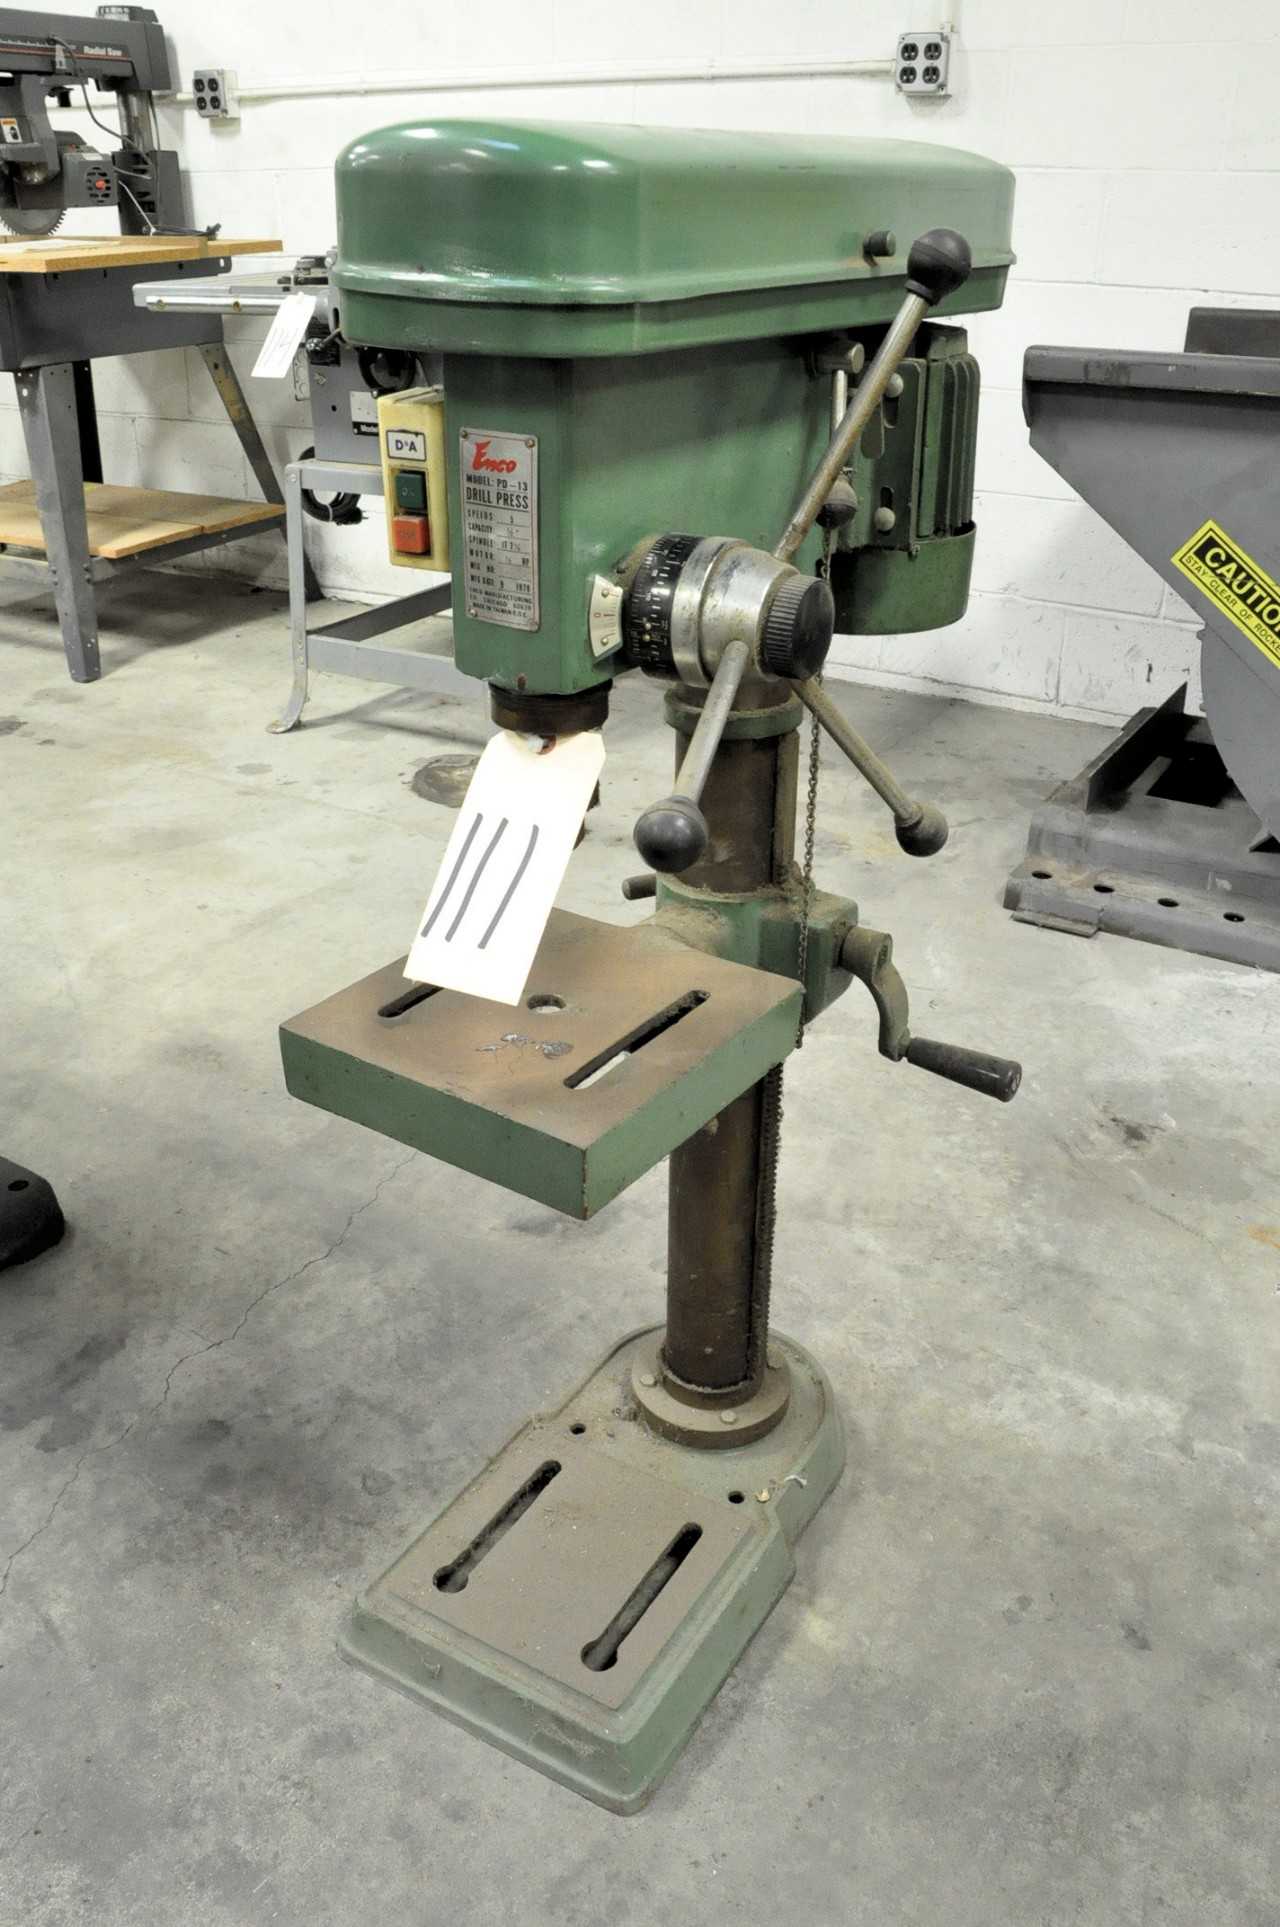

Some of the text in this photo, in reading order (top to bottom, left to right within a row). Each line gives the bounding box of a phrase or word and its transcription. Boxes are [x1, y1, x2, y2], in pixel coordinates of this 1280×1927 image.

[473, 440, 517, 473] Enco
[466, 487, 529, 510] DRILL PRESS
[1185, 555, 1208, 579] STAY
[1209, 579, 1238, 608] CLEAR
[1239, 608, 1254, 622] OF
[1204, 547, 1280, 633] CAUTIO
